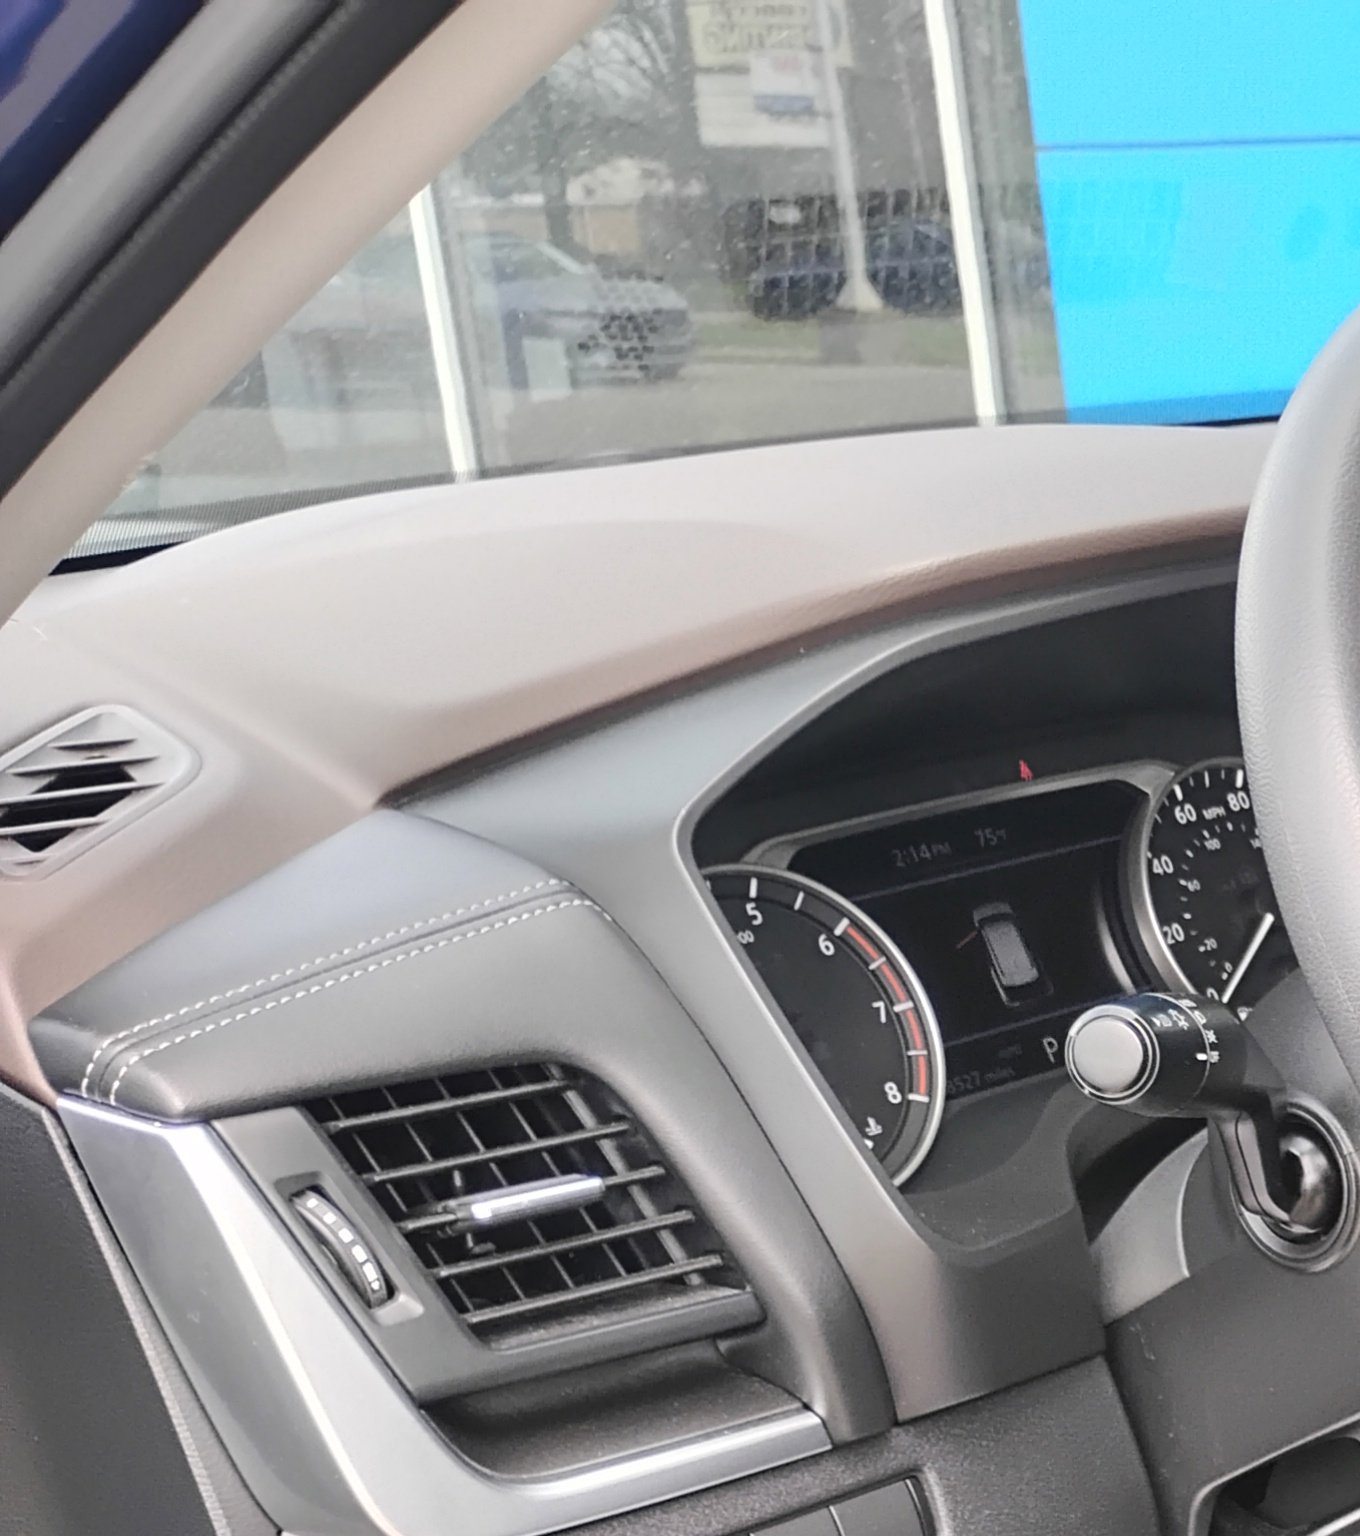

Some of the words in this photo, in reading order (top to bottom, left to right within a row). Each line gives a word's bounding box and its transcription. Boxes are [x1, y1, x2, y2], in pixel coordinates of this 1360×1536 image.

[1202, 805, 1227, 820] MPH
[1226, 790, 1251, 812] 80
[1174, 803, 1198, 825] 60
[1152, 854, 1175, 876] 40
[745, 902, 764, 926] 5
[818, 933, 836, 956] 6
[1163, 922, 1185, 945] 20
[872, 1000, 887, 1024] 7
[1042, 1036, 1059, 1064] P
[883, 1081, 902, 1104] 8
